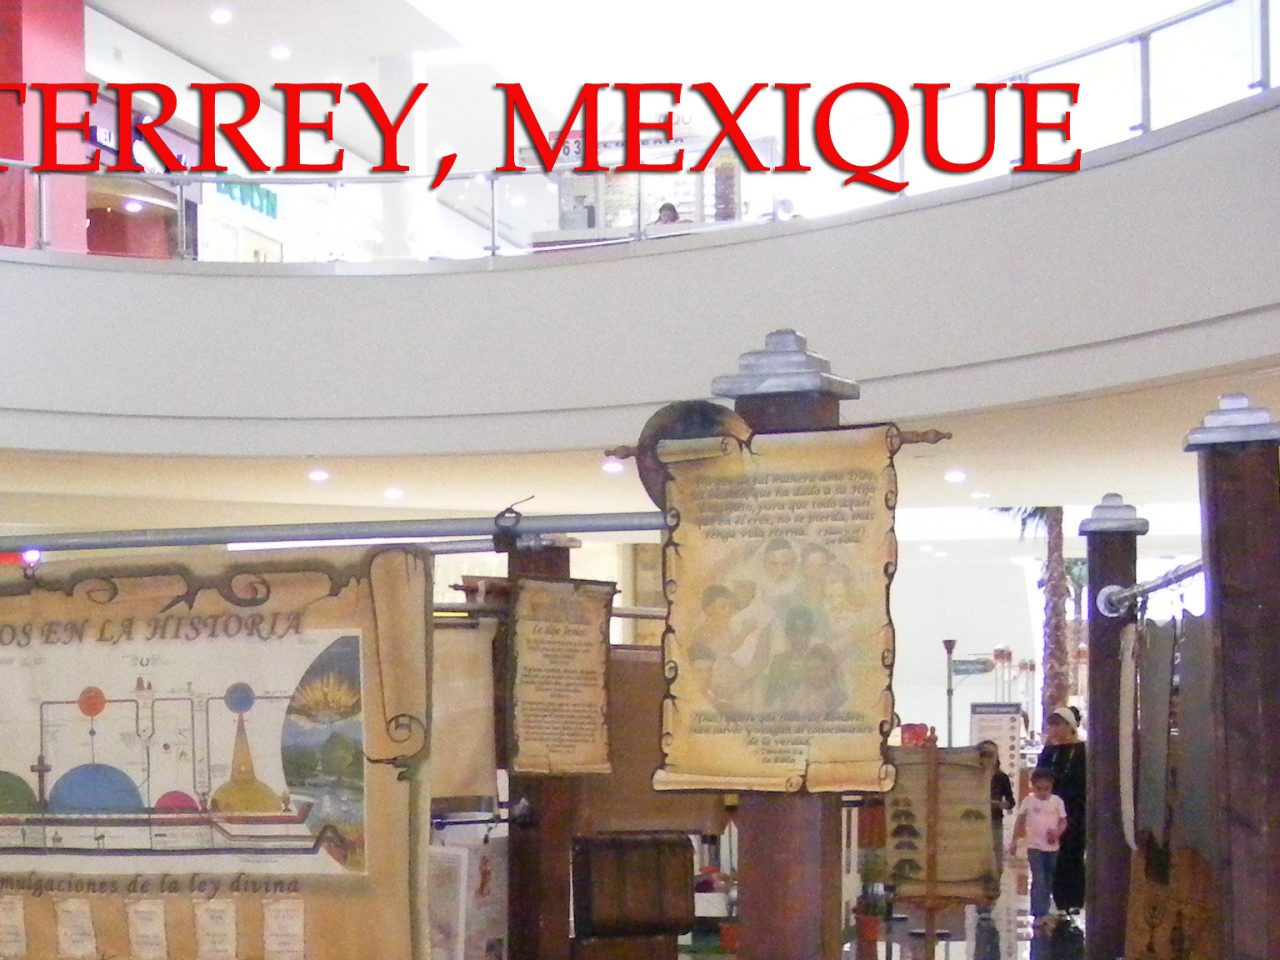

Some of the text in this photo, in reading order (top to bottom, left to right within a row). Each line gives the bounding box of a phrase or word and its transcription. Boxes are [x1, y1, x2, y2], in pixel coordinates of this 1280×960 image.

[40, 619, 88, 645] EN
[96, 617, 137, 645] LA
[145, 611, 303, 642] HISTORIA
[127, 873, 151, 894] de
[159, 873, 180, 894] la
[189, 872, 220, 901] ley
[230, 872, 301, 894] divina
